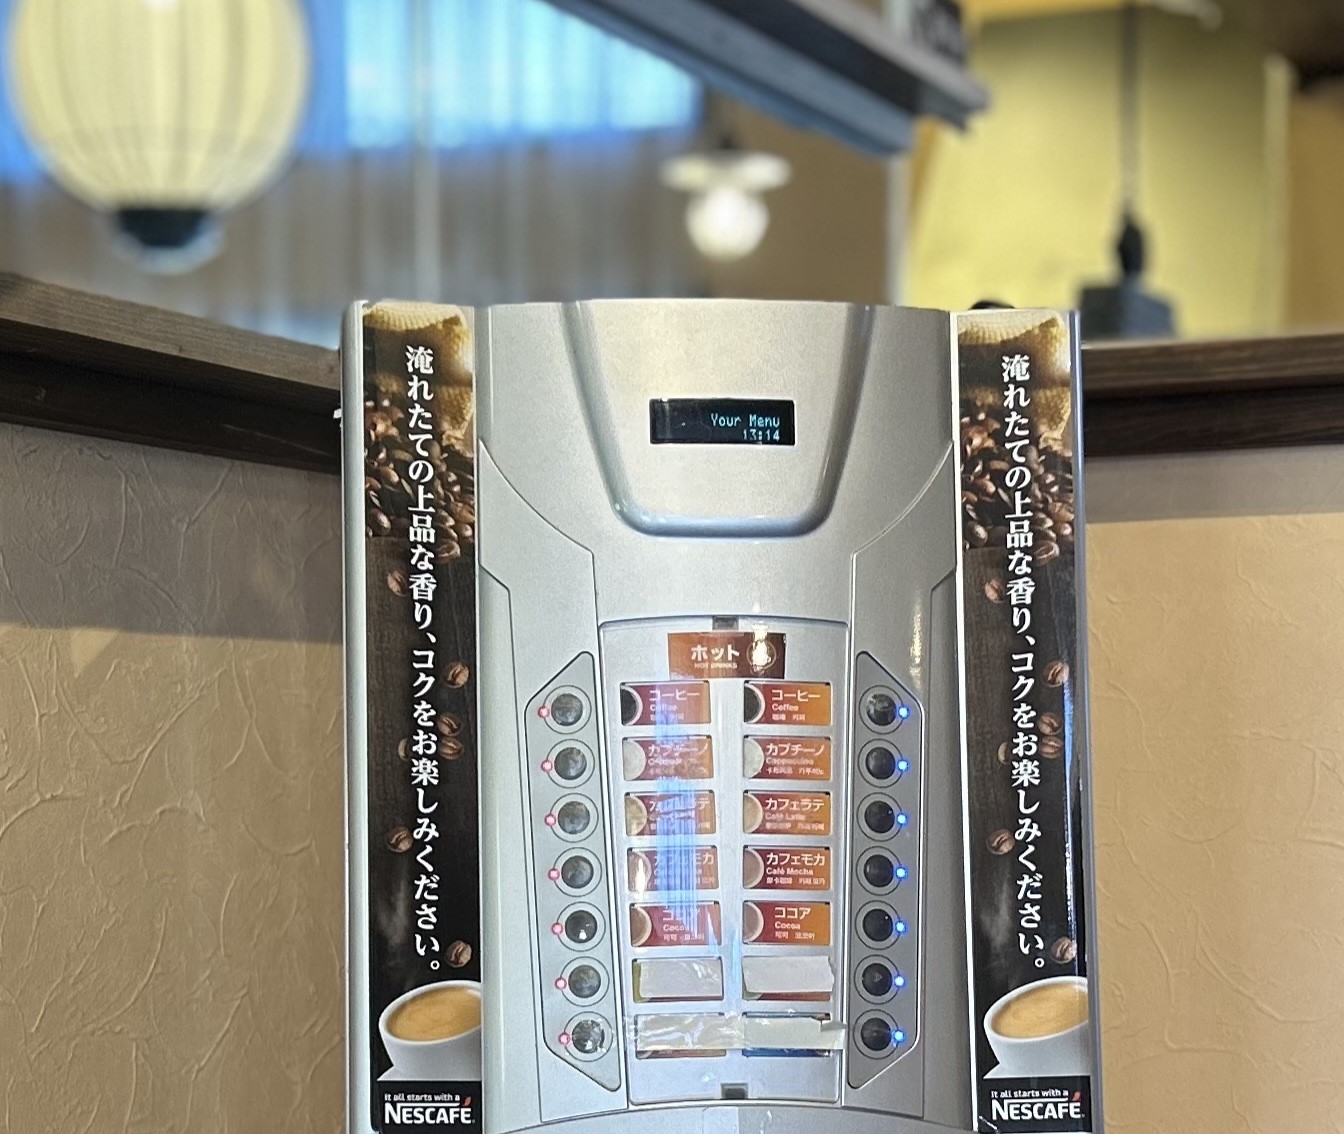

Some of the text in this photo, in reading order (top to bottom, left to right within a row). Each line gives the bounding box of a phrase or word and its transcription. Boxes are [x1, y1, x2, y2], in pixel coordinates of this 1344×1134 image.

[710, 413, 780, 428] Your Menu
[743, 428, 780, 441] 13:14
[405, 345, 440, 970] 淹れたての上品な香り、コクをお楽しみください。
[691, 644, 740, 661] ホット
[1001, 354, 1045, 969] 淹れたての上品な香り、コクをお楽しみください。
[649, 689, 700, 701] コーヒー
[771, 689, 821, 701] コーヒー
[772, 703, 799, 712] Coffee
[765, 798, 825, 811] カフェラテ
[766, 853, 825, 866] カフェモカ
[766, 866, 784, 875] Café
[775, 907, 812, 920] ココア
[775, 921, 800, 930] Cocoa
[407, 1093, 432, 1101] starts
[434, 1093, 453, 1101] with
[1014, 1089, 1039, 1098] starts
[1041, 1088, 1061, 1097] with
